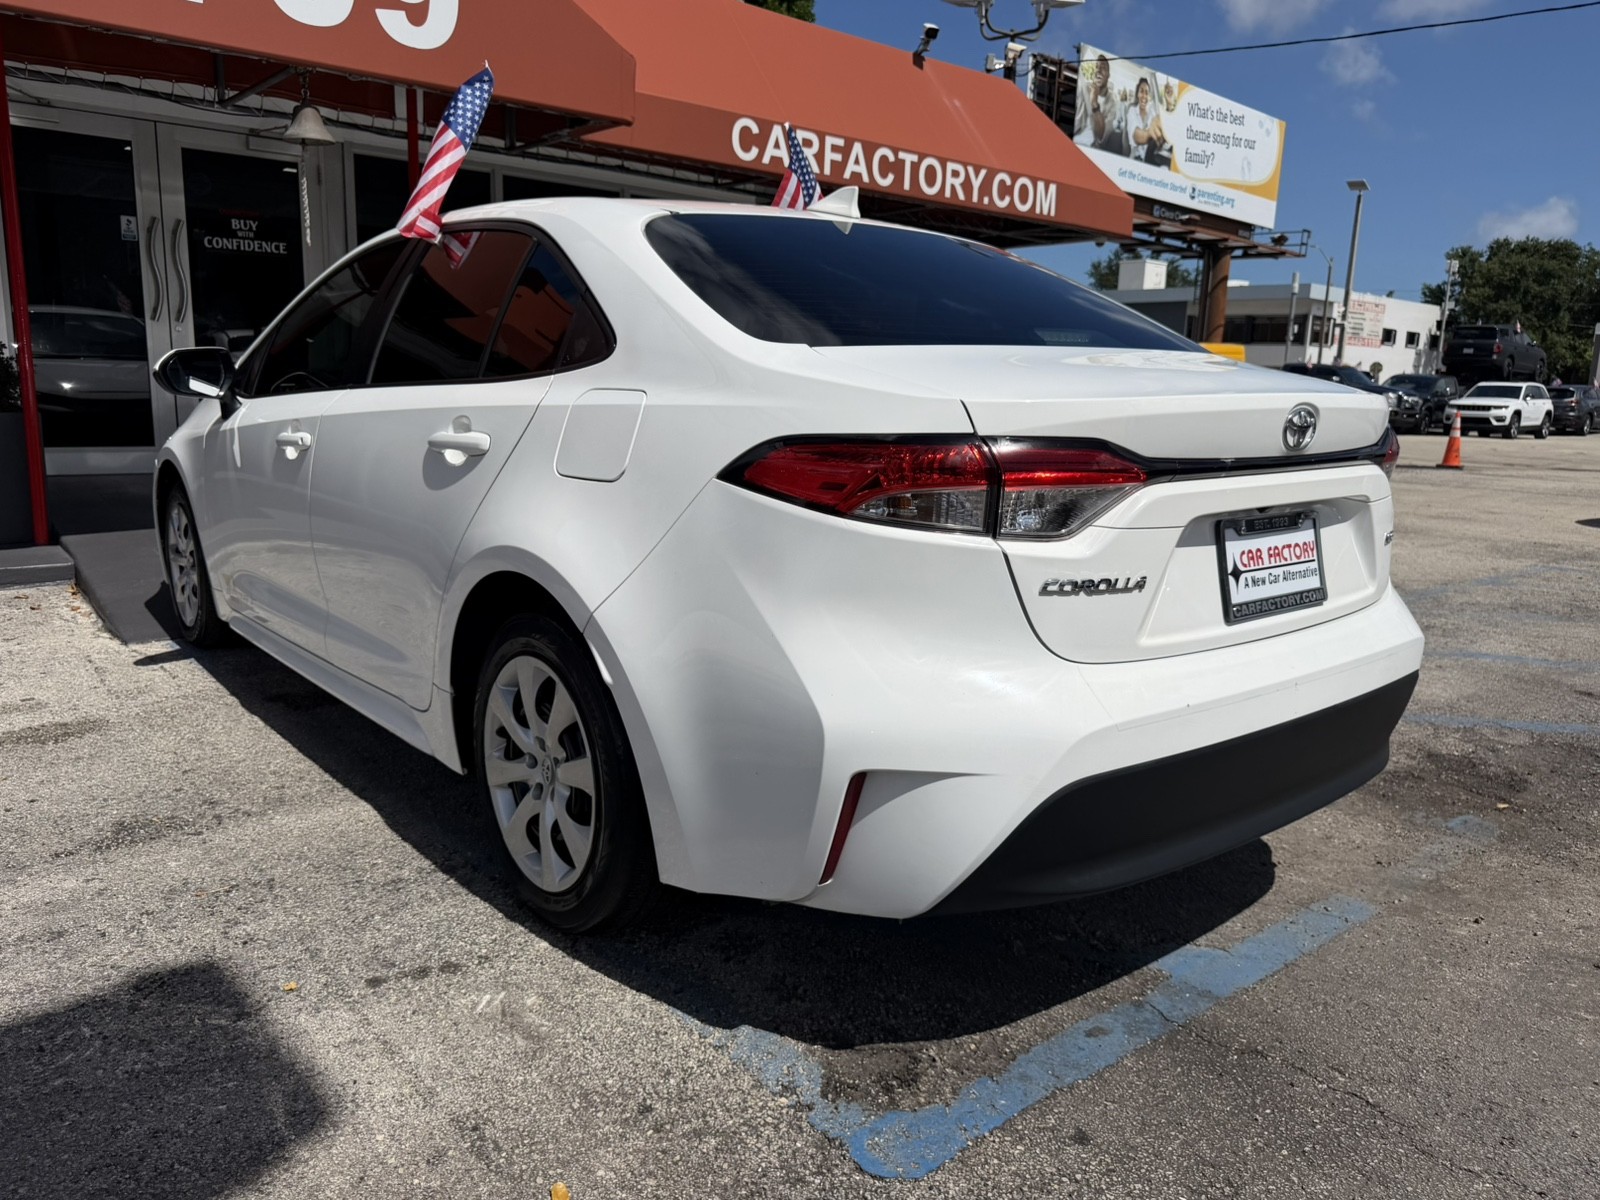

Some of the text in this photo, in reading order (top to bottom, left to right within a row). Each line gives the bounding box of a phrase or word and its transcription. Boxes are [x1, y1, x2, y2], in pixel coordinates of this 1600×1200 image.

[1187, 102, 1245, 126] What's the best
[1186, 125, 1256, 150] theme song for our
[732, 117, 1058, 217] CARFACTORY.COM
[1185, 147, 1215, 168] family?
[1118, 168, 1188, 194] Get the Conversation Started
[1197, 188, 1235, 208] parenting.org
[231, 218, 258, 231] BUY
[204, 236, 287, 254] CONFIDENCE
[1240, 540, 1316, 568] CAR FACTORY
[1038, 576, 1147, 597] COROLLA
[1244, 566, 1318, 589] A New Car Alternative
[1234, 589, 1324, 617] CARFACTORY.COM
